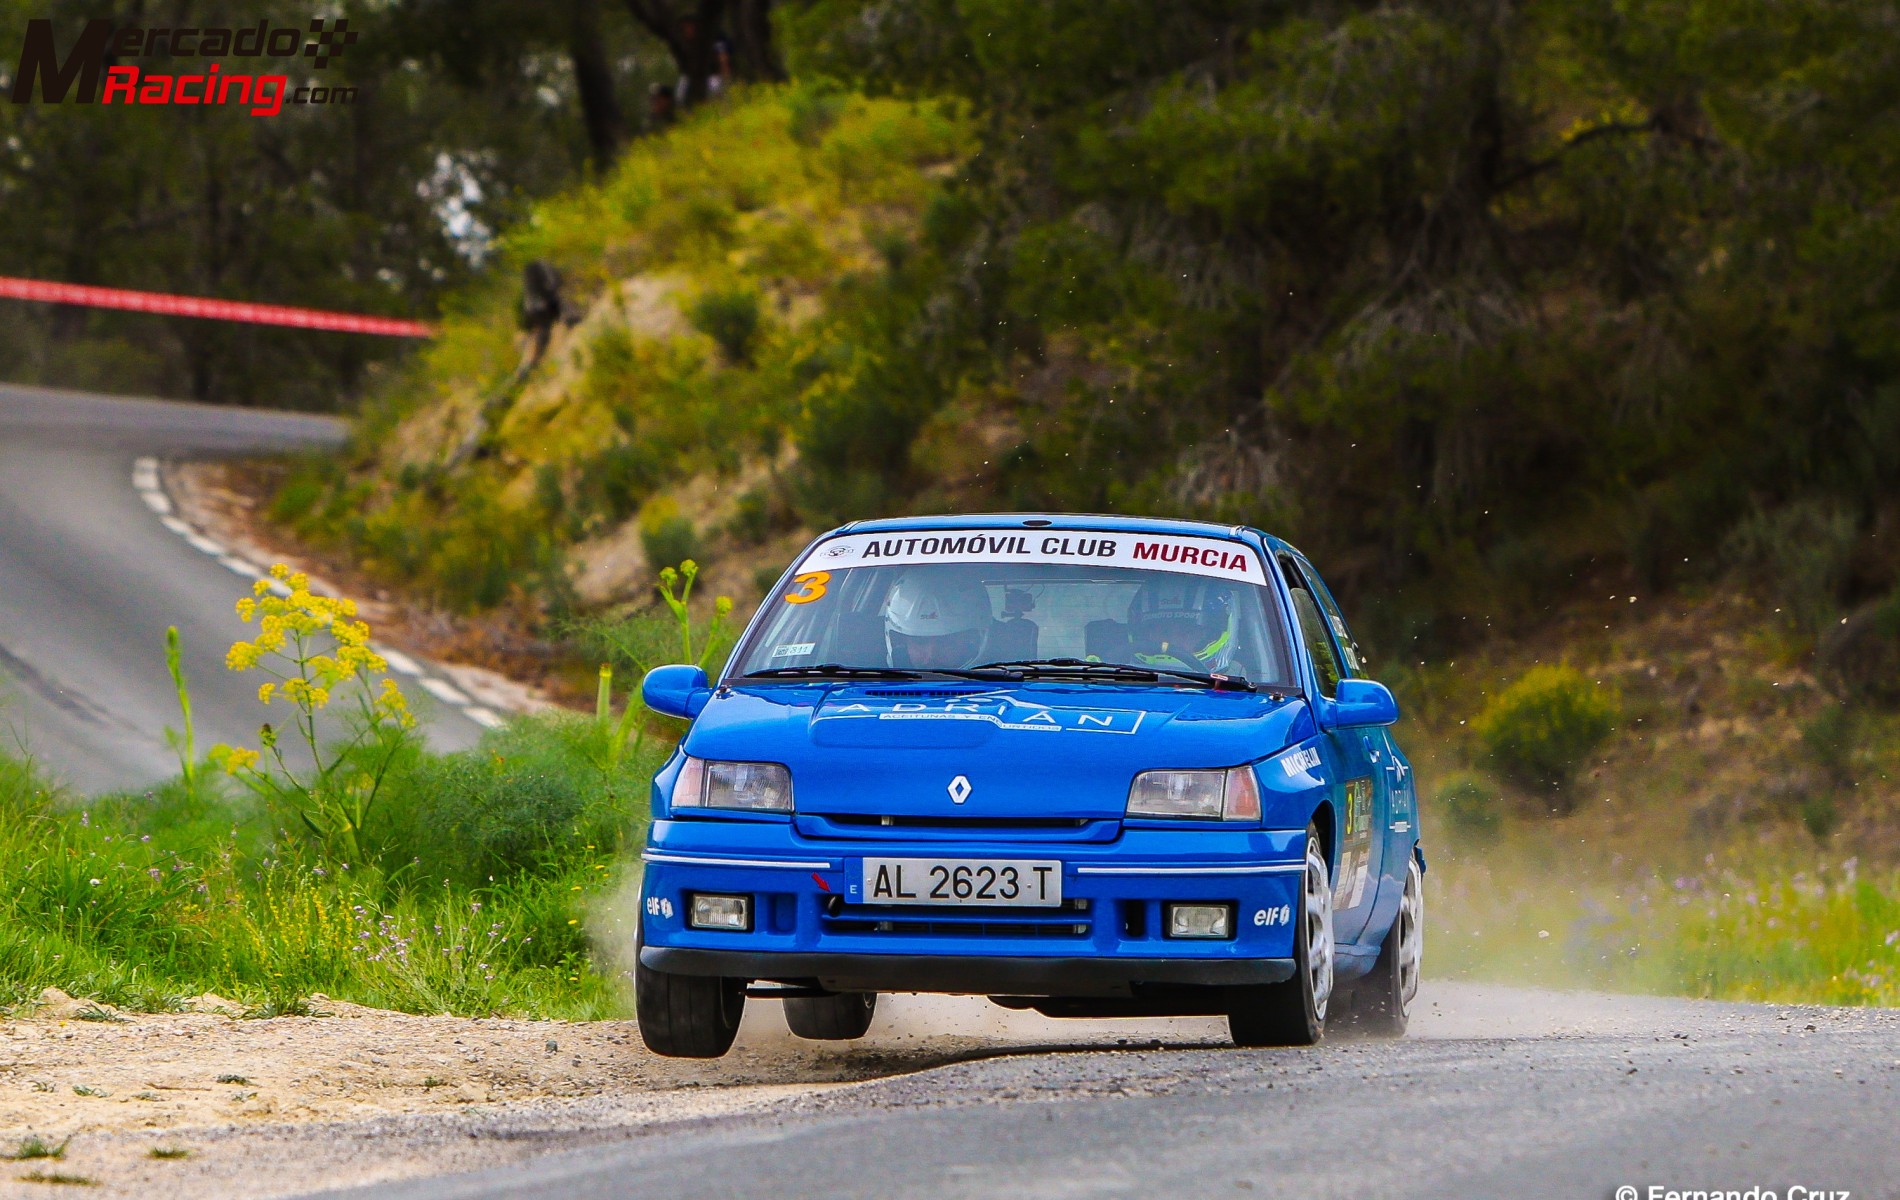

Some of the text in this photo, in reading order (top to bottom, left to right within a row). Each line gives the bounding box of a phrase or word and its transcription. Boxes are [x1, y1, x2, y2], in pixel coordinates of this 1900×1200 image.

[861, 534, 1031, 559] AUTOMÓVIL
[1041, 537, 1117, 557] CLUB
[1132, 542, 1248, 572] MURCIA
[784, 571, 832, 605] 3
[1280, 746, 1322, 778] MICHELIN
[850, 885, 857, 894] E
[873, 864, 1053, 900] AL 2623 T
[646, 896, 660, 916] elf
[1253, 906, 1280, 926] elf
